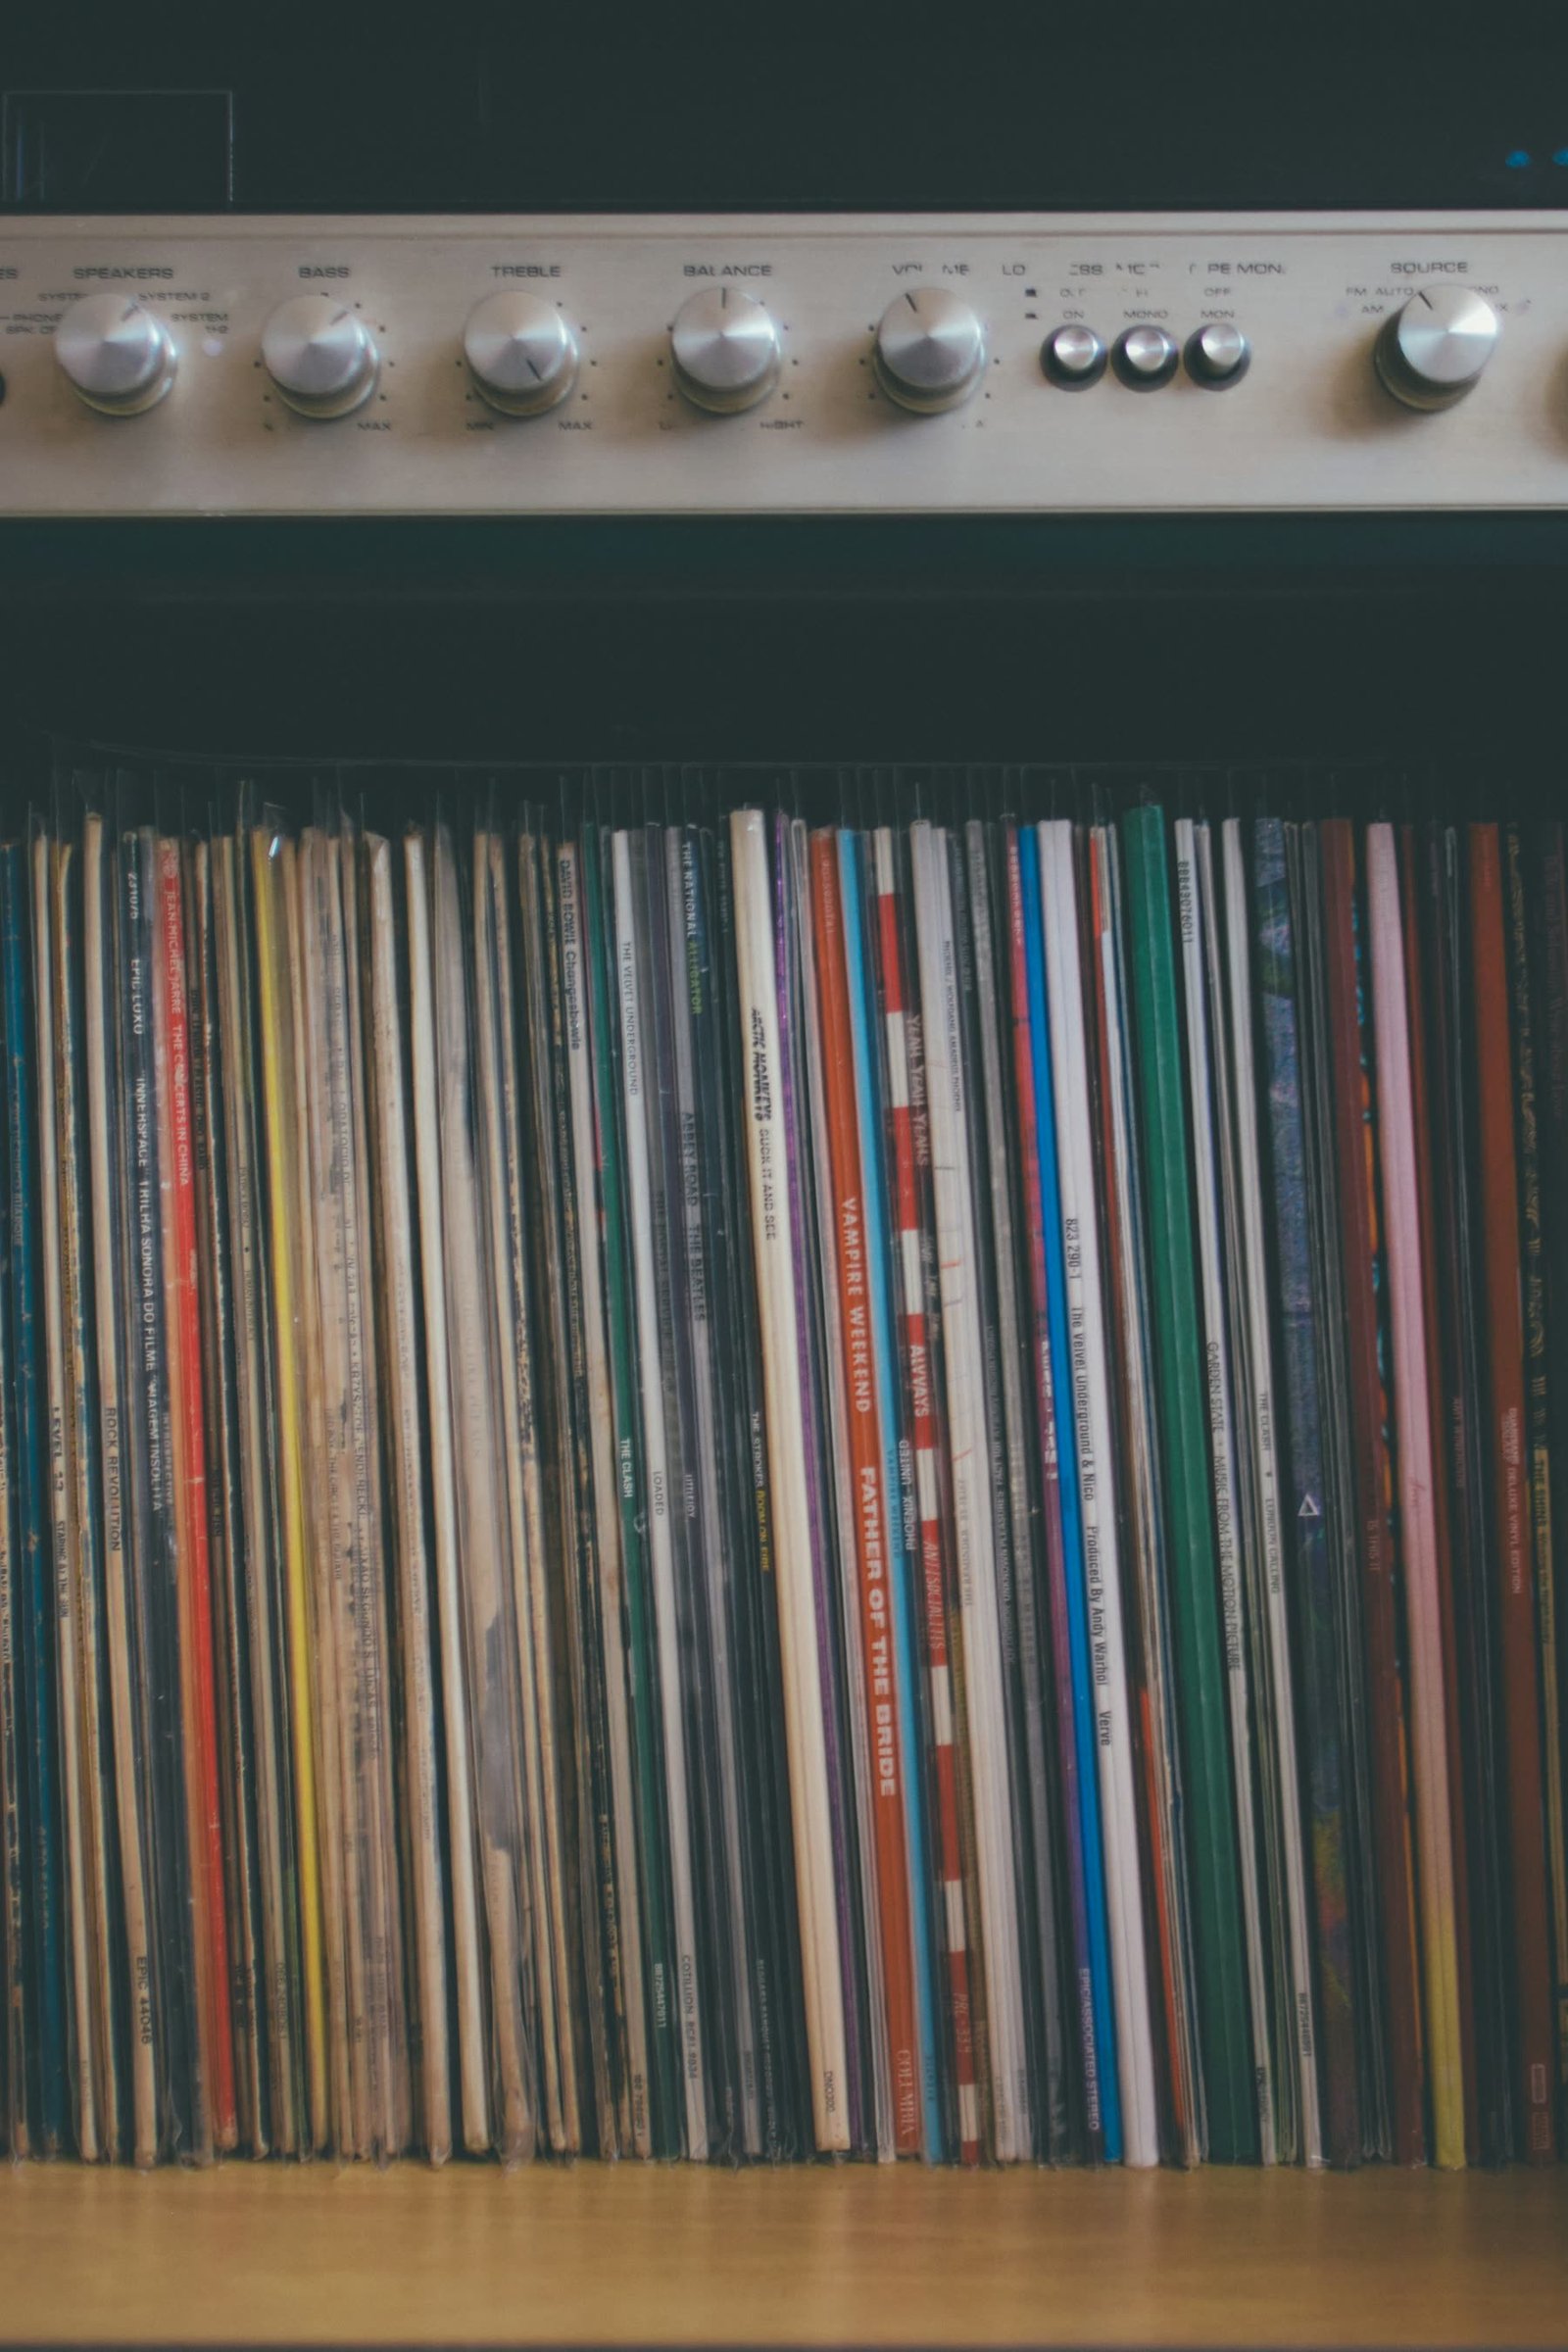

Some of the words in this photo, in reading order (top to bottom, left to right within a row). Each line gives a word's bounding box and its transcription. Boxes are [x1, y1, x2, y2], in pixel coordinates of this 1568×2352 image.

[74, 268, 173, 279] SPEAKERS
[299, 266, 350, 278] BASS
[491, 266, 561, 277] TREBLE
[684, 265, 772, 276] BALANCE
[1391, 262, 1469, 273] SOURCE
[1361, 305, 1384, 314] AM
[1375, 287, 1414, 296] AUTO
[1062, 310, 1085, 318] ON
[1123, 310, 1169, 318] MONO
[1200, 310, 1235, 318] MON
[680, 842, 692, 866] THE
[560, 859, 572, 898] DAVID
[681, 870, 697, 937] NATIONAL
[165, 891, 180, 976] JEAN-MICHEL
[562, 904, 575, 945] BOWIE
[618, 941, 631, 962] THE
[169, 978, 182, 1013] JARRE
[620, 966, 634, 1003] VELVET
[686, 942, 702, 1013] ALLIGATOR
[131, 994, 144, 1034] LUXO
[750, 1006, 765, 1050] ARCTIC
[171, 1025, 183, 1050] THE
[622, 1006, 640, 1096] UNDERGROUND
[906, 1015, 923, 1057] YEAH
[750, 1051, 771, 1121] MONKEYS
[908, 1064, 926, 1106] YEAH
[175, 1126, 187, 1140] IN
[680, 1112, 695, 1160] ABBEY
[758, 1128, 772, 1164] SUCK
[911, 1113, 929, 1166] YEAHS
[175, 1143, 189, 1186] CHINA
[760, 1168, 773, 1179] IT
[683, 1164, 698, 1206] ROAD
[761, 1184, 775, 1212] AND
[687, 1225, 701, 1252] THE
[763, 1215, 776, 1240] SEE
[842, 1198, 861, 1296] VAMPIRE
[1065, 1218, 1080, 1240] 823
[140, 1238, 154, 1298] SONORA
[1066, 1245, 1082, 1279] 290-1
[689, 1258, 705, 1320] BEATLES
[142, 1301, 154, 1323] DO
[1070, 1306, 1085, 1327] The
[143, 1327, 156, 1371] FILME
[849, 1306, 868, 1413] WEEKEND
[1072, 1333, 1088, 1369] Velvet
[1205, 1341, 1221, 1393] GARDEN
[909, 1345, 928, 1417] ALVVAYS
[750, 1412, 760, 1431] THE
[1073, 1375, 1093, 1453] Underground
[1209, 1398, 1224, 1433] STATE
[1257, 1393, 1270, 1411] THE
[104, 1407, 118, 1448] ROCK
[1259, 1415, 1272, 1450] CLASH
[162, 1412, 172, 1503] INTROSPECTIVE
[618, 1438, 631, 1459] THE
[751, 1437, 763, 1487] STROKES
[898, 1440, 911, 1484] UNITED
[620, 1462, 633, 1497] CLASH
[651, 1471, 664, 1515] LOADED
[1081, 1473, 1096, 1500] Nico
[1212, 1455, 1228, 1494] MUSIC
[1505, 1468, 1517, 1512] DELUXE
[106, 1456, 122, 1550] REVOLUTION
[755, 1490, 765, 1523] ROOM
[859, 1466, 882, 1579] FATHER
[902, 1495, 915, 1550] PHOENIX
[1215, 1498, 1231, 1533] FROM
[758, 1526, 767, 1542] ON
[1507, 1514, 1519, 1544] VINYL
[759, 1546, 768, 1572] FIRE
[1085, 1526, 1102, 1583] Produced
[1218, 1539, 1233, 1561] THE
[1267, 1547, 1281, 1593] CALLING
[1509, 1549, 1522, 1592] EDITION
[867, 1588, 885, 1622] OF
[1086, 1589, 1102, 1601] By
[1220, 1564, 1237, 1618] MOTION
[1087, 1607, 1104, 1637] Andy
[870, 1634, 889, 1695] THE
[1092, 1642, 1107, 1686] Warhol
[1224, 1623, 1241, 1671] PICTURE
[1098, 1711, 1112, 1745] Verve
[874, 1703, 895, 1796] BRIDE
[136, 1956, 148, 1989] EPIC
[680, 1954, 694, 2013] COTILLION
[138, 1997, 151, 2043] 44046
[1078, 1967, 1096, 2077] EPIC/ASSOCIATED
[895, 2050, 916, 2134] COLUMBIA
[1085, 2080, 1099, 2131] STEREO
